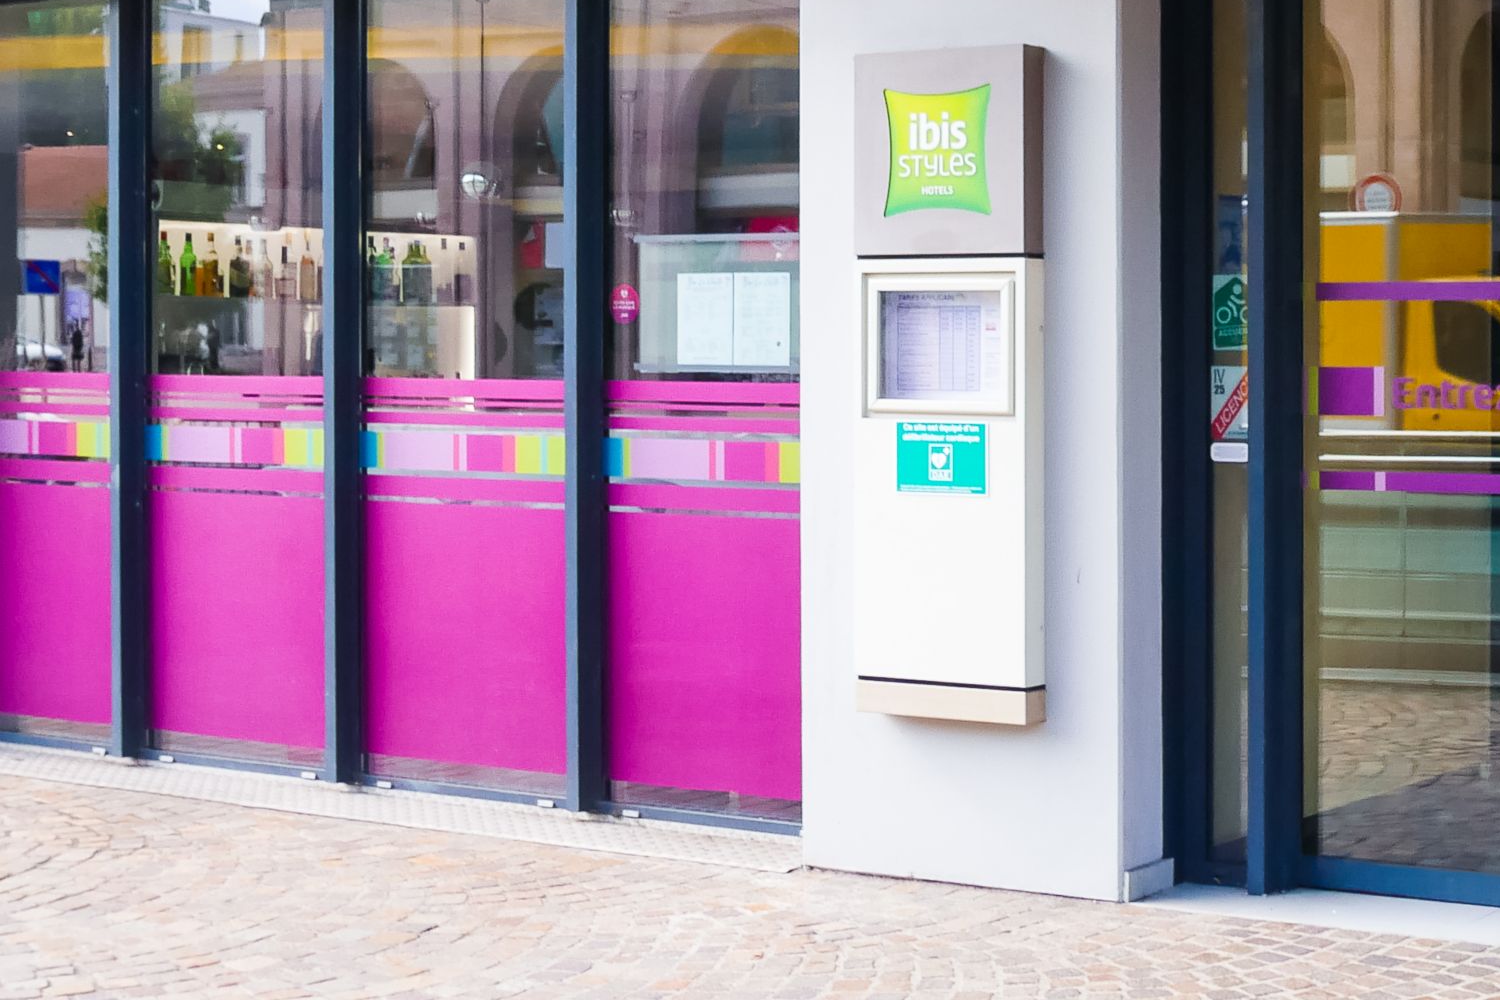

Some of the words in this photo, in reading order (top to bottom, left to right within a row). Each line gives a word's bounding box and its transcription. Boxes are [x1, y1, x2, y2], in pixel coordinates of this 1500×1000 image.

[908, 112, 967, 150] ibis
[921, 185, 954, 196] HOTELS
[1215, 374, 1248, 434] LICENC
